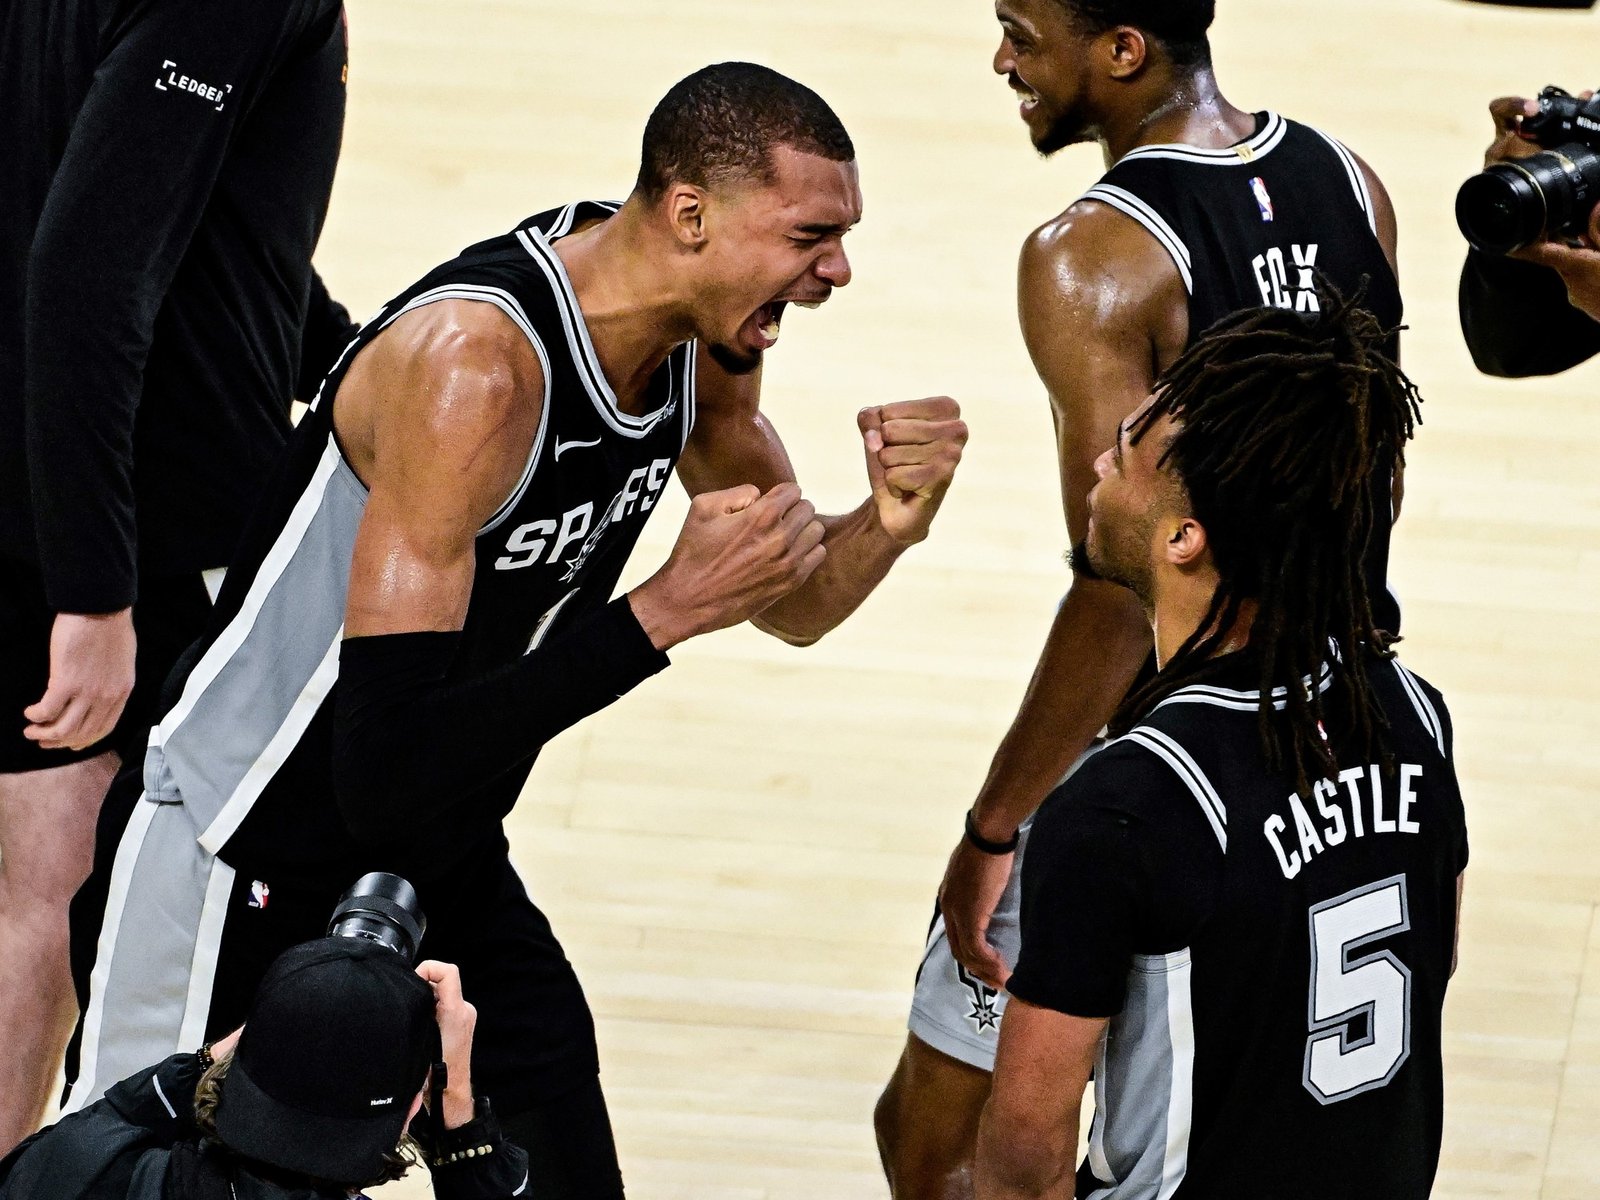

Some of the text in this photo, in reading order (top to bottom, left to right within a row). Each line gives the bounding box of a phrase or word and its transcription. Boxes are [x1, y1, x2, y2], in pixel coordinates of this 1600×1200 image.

[167, 71, 223, 102] LEDGER
[1252, 244, 1320, 311] FOX
[1264, 763, 1423, 879] CASTLE
[1302, 873, 1412, 1105] 5
